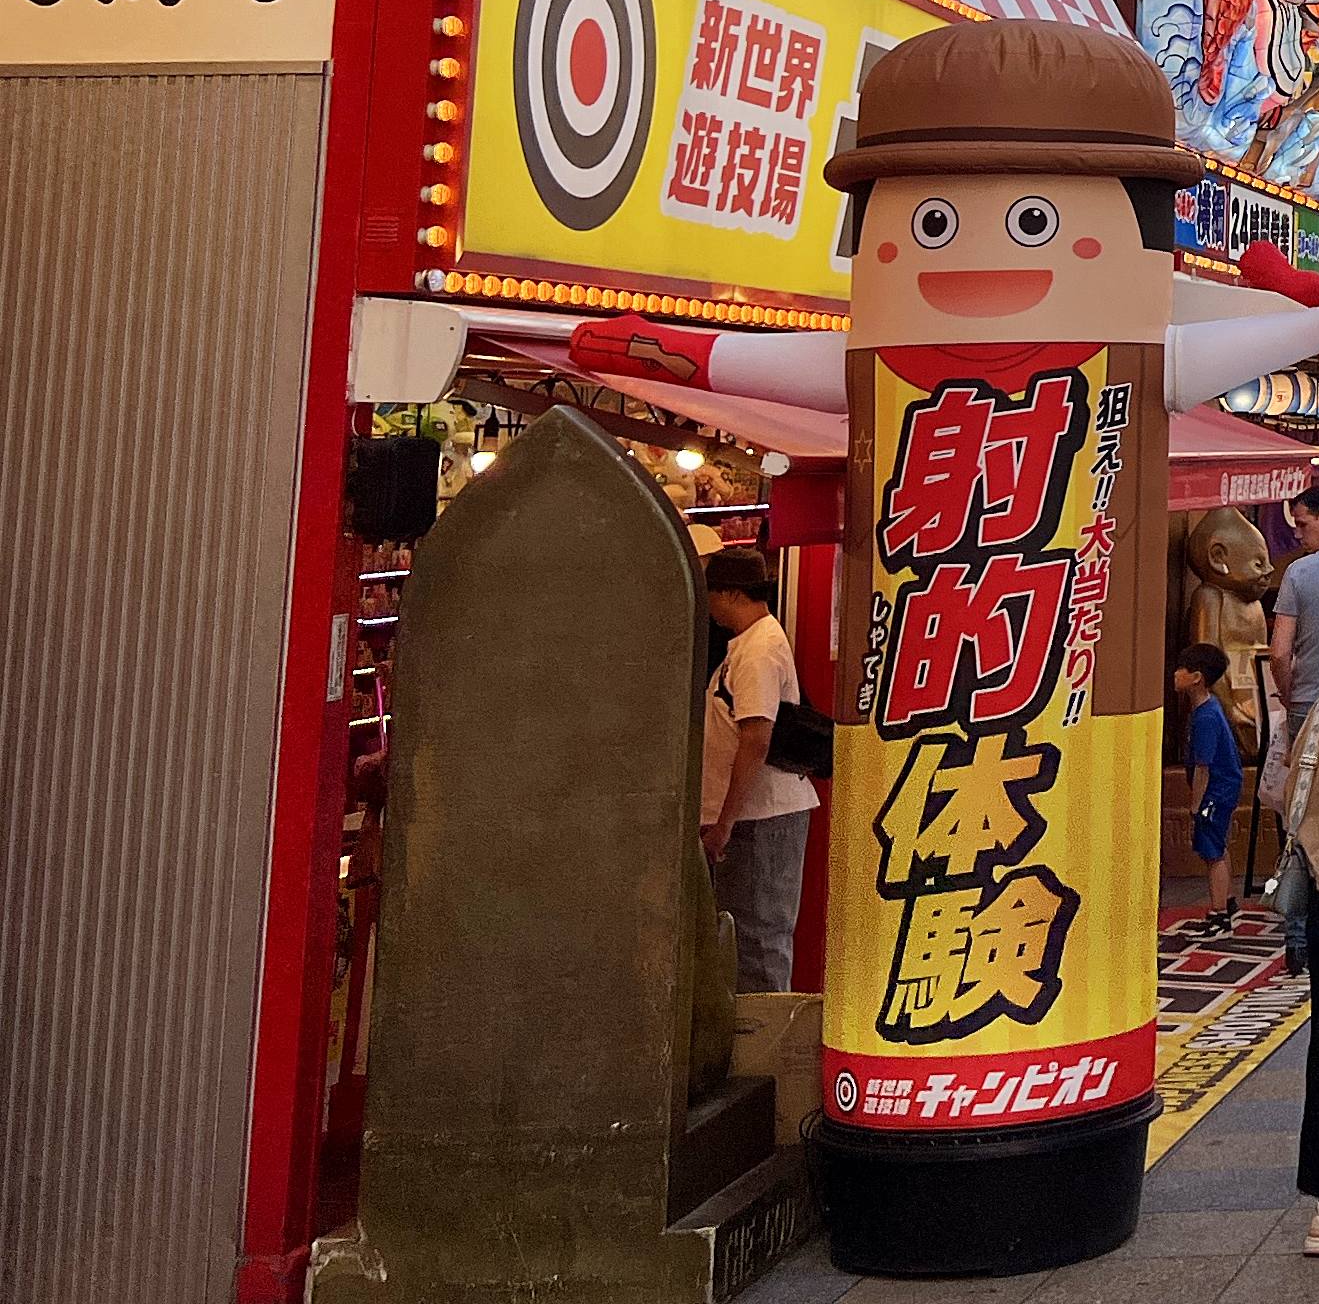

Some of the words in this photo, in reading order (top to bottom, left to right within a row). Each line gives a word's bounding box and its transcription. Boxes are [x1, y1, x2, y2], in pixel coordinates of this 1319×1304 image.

[668, 108, 806, 226] 遊技場
[881, 374, 1077, 1034] 射的体験
[866, 1078, 914, 1096] 新世界
[915, 1056, 1119, 1119] チャンピオン
